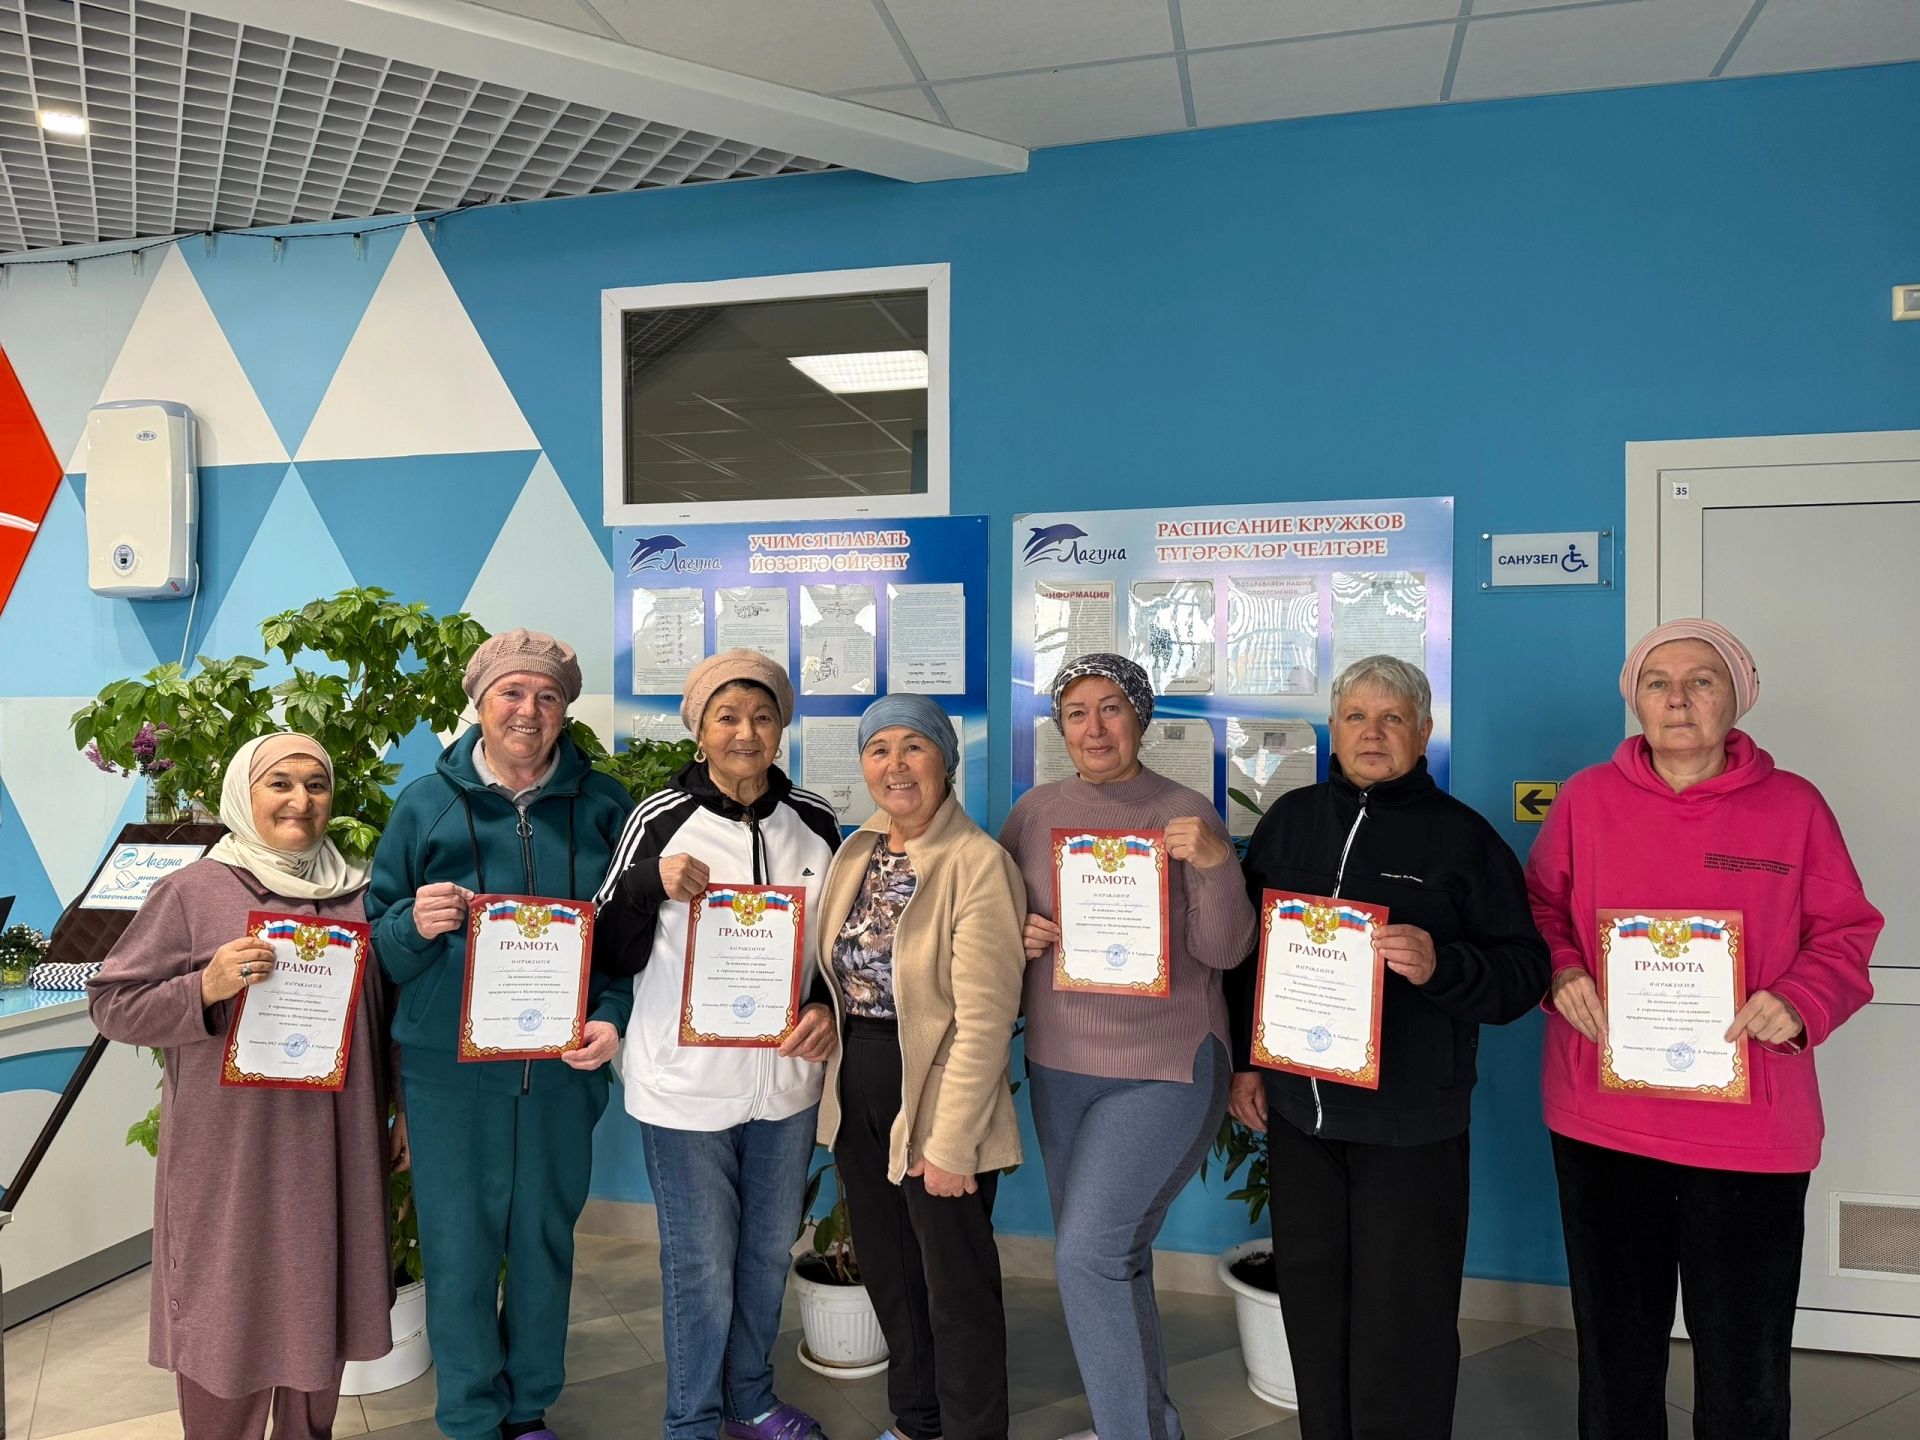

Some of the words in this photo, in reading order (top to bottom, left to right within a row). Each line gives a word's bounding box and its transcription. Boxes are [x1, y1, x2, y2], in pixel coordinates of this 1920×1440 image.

[1675, 486, 1688, 496] 35
[1157, 518, 1293, 537] РАСПИСАНИЕ
[1299, 514, 1404, 532] КРУЖКОВ
[750, 534, 824, 549] УЧИМСЯ
[828, 532, 908, 547] ПЛАВАТЬ
[1057, 541, 1127, 565] Лагуна
[1157, 543, 1288, 561] ТҮГӘРӘКЛӘР
[1293, 540, 1386, 557] ЧЕЛТӘРЕ
[660, 551, 721, 573] Лагуна
[1498, 554, 1558, 565] САНУЗЕЛ
[136, 852, 183, 869] Лагуна
[1081, 874, 1137, 885] ГРАМОТА
[718, 927, 774, 939] ГРАМОТА
[499, 940, 559, 951] ГРАМОТА
[1288, 942, 1348, 962] ГРАМОТА
[274, 960, 332, 976] ГРАМОТА
[1634, 960, 1705, 973] ГРАМОТА
